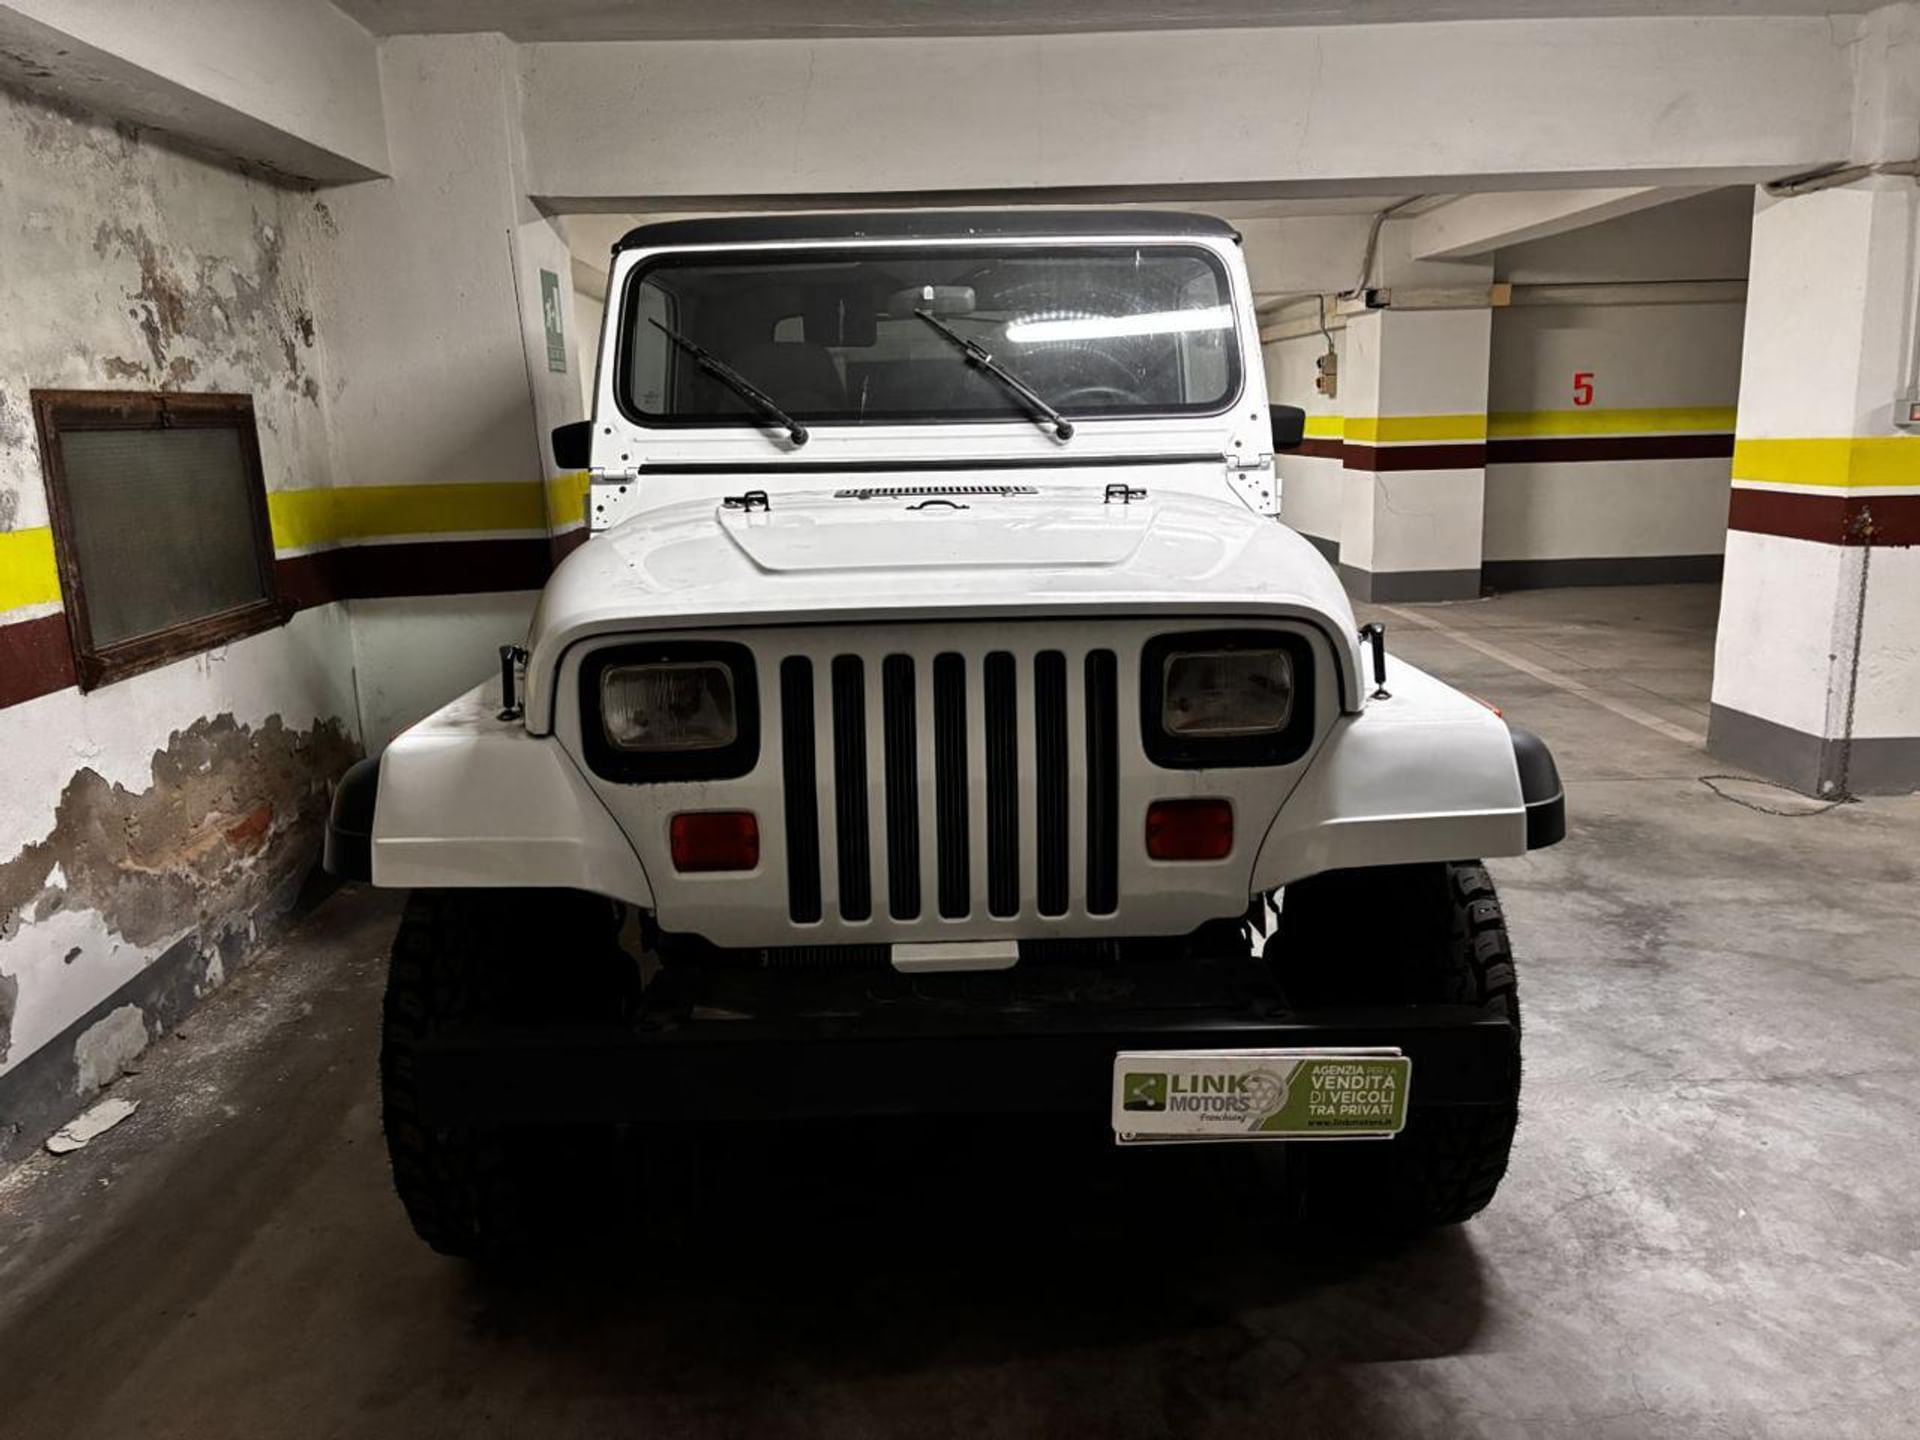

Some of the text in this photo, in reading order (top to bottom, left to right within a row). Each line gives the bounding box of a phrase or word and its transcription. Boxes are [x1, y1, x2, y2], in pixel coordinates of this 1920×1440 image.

[1573, 373, 1594, 406] 5
[1312, 1065, 1364, 1075] AGENZIA
[1171, 1074, 1249, 1093] LINK
[1312, 1076, 1395, 1089] VENDITA
[1310, 1091, 1394, 1103] DI VEICOLI
[1170, 1096, 1250, 1112] MOTORS
[1308, 1105, 1393, 1115] TRA PRIVATI
